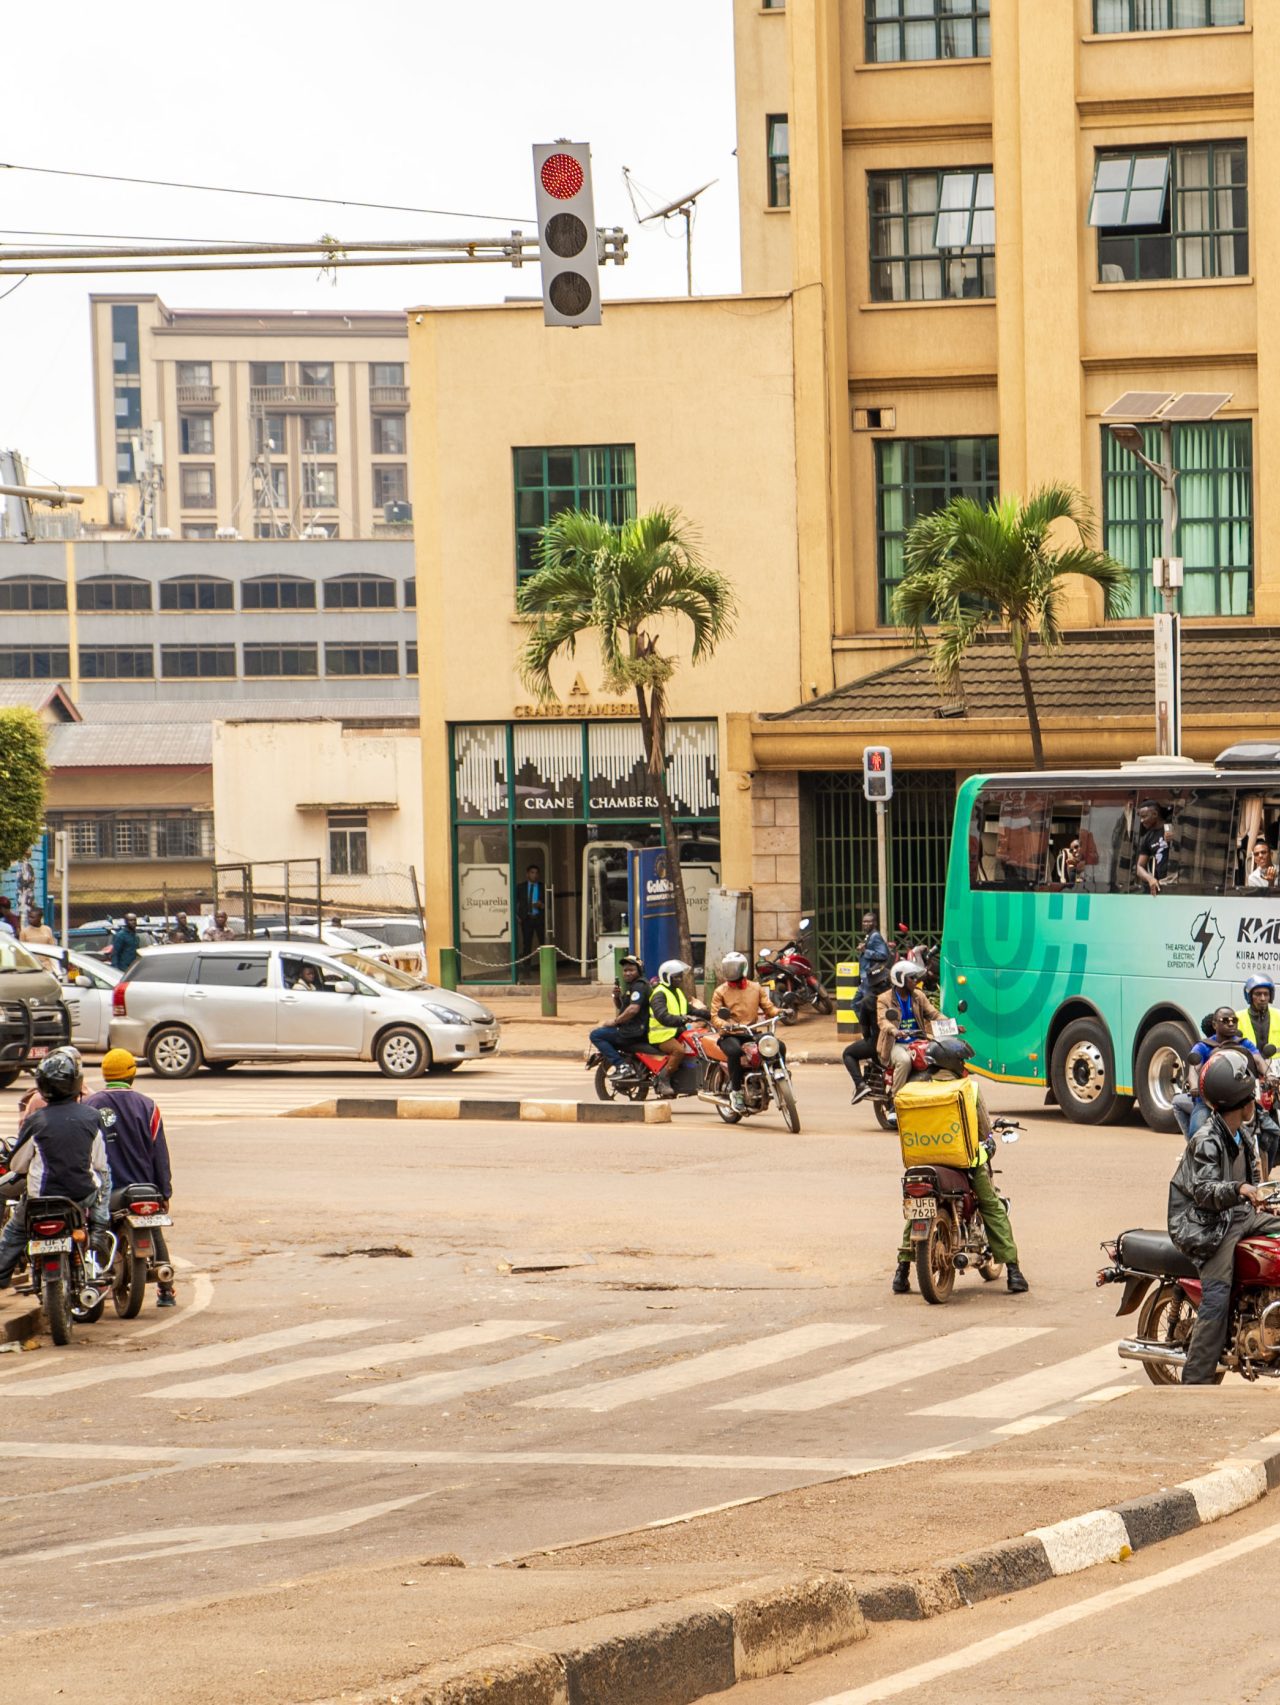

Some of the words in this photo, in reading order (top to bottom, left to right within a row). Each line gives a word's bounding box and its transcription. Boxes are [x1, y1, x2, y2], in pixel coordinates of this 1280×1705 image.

[513, 704, 563, 718] CRANE
[524, 798, 574, 809] CRANE
[589, 796, 659, 809] CHAMBERS
[466, 896, 508, 908] Ruparelia
[1165, 943, 1174, 951] THE
[1174, 944, 1195, 952] AFRICAN
[1236, 951, 1255, 960] KIIRA
[1167, 961, 1195, 969] EXPEDITION
[903, 1131, 953, 1147] Glovo
[915, 1199, 934, 1208] UFG
